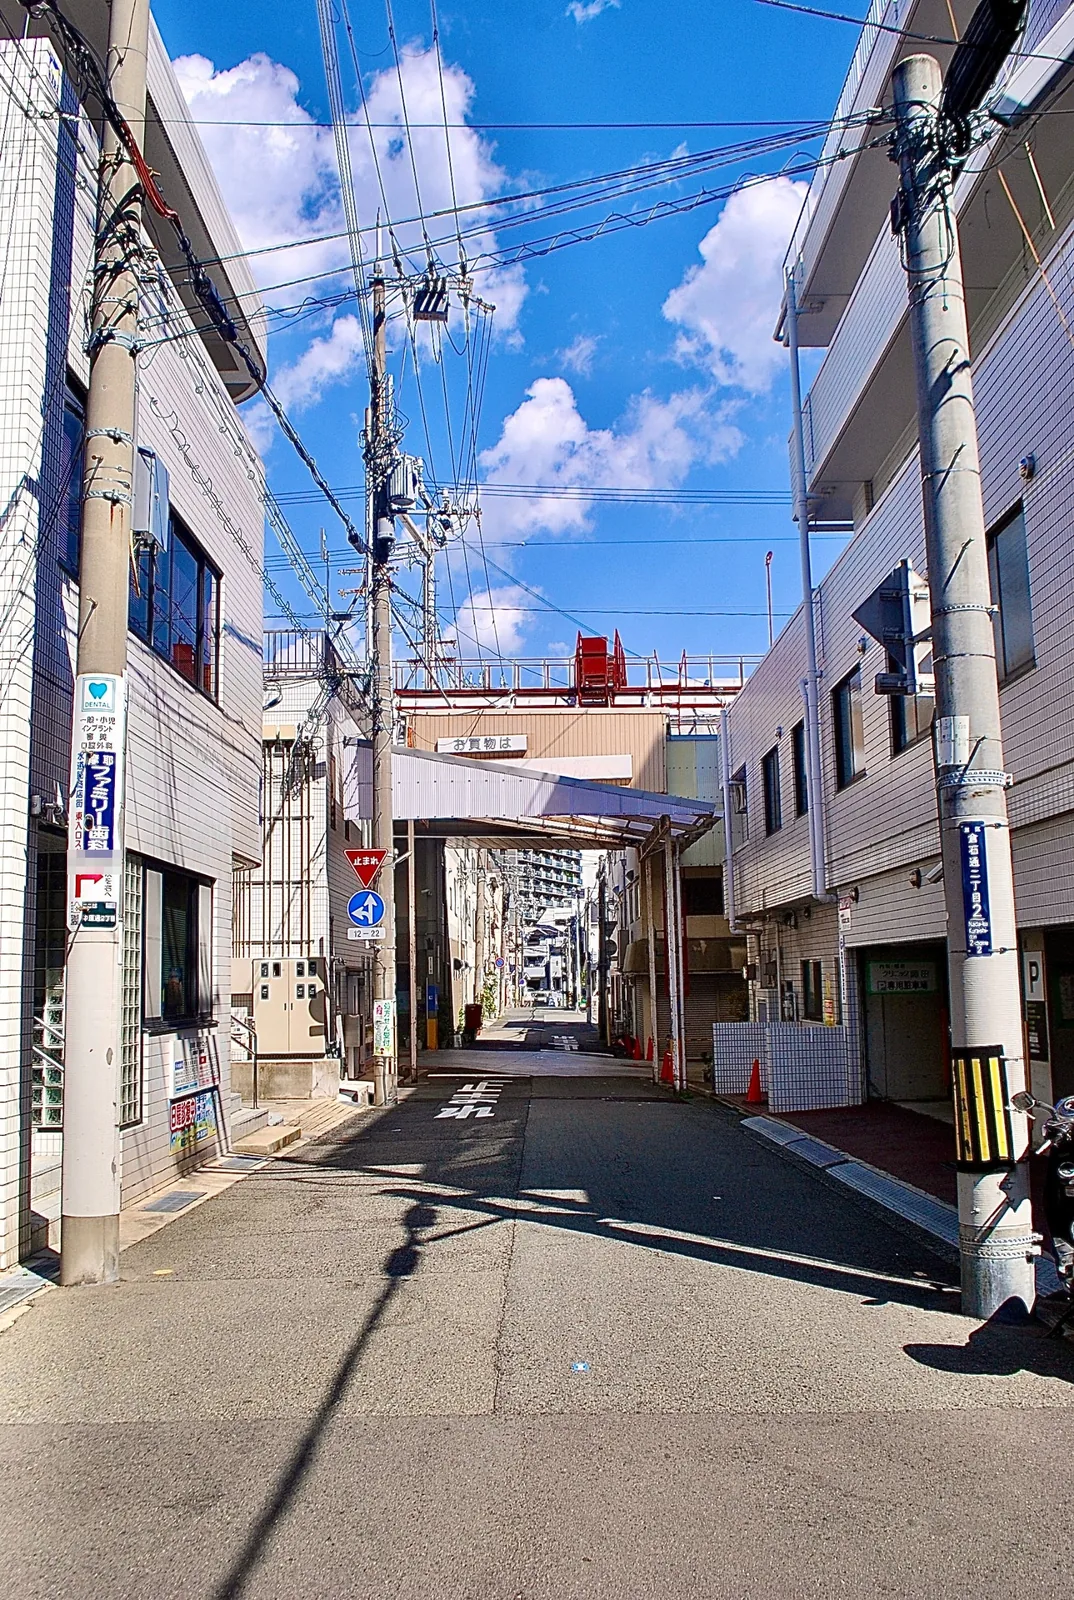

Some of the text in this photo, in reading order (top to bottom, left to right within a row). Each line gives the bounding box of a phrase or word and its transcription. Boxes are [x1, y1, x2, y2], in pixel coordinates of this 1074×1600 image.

[80, 716, 116, 725] 一般・小児
[454, 737, 511, 751] お買物は
[353, 856, 380, 866] 止まれ
[976, 946, 983, 955] 2
[1028, 960, 1040, 994] P
[383, 1002, 391, 1047] 処方せん受付
[433, 1079, 514, 1120] 止まれ
